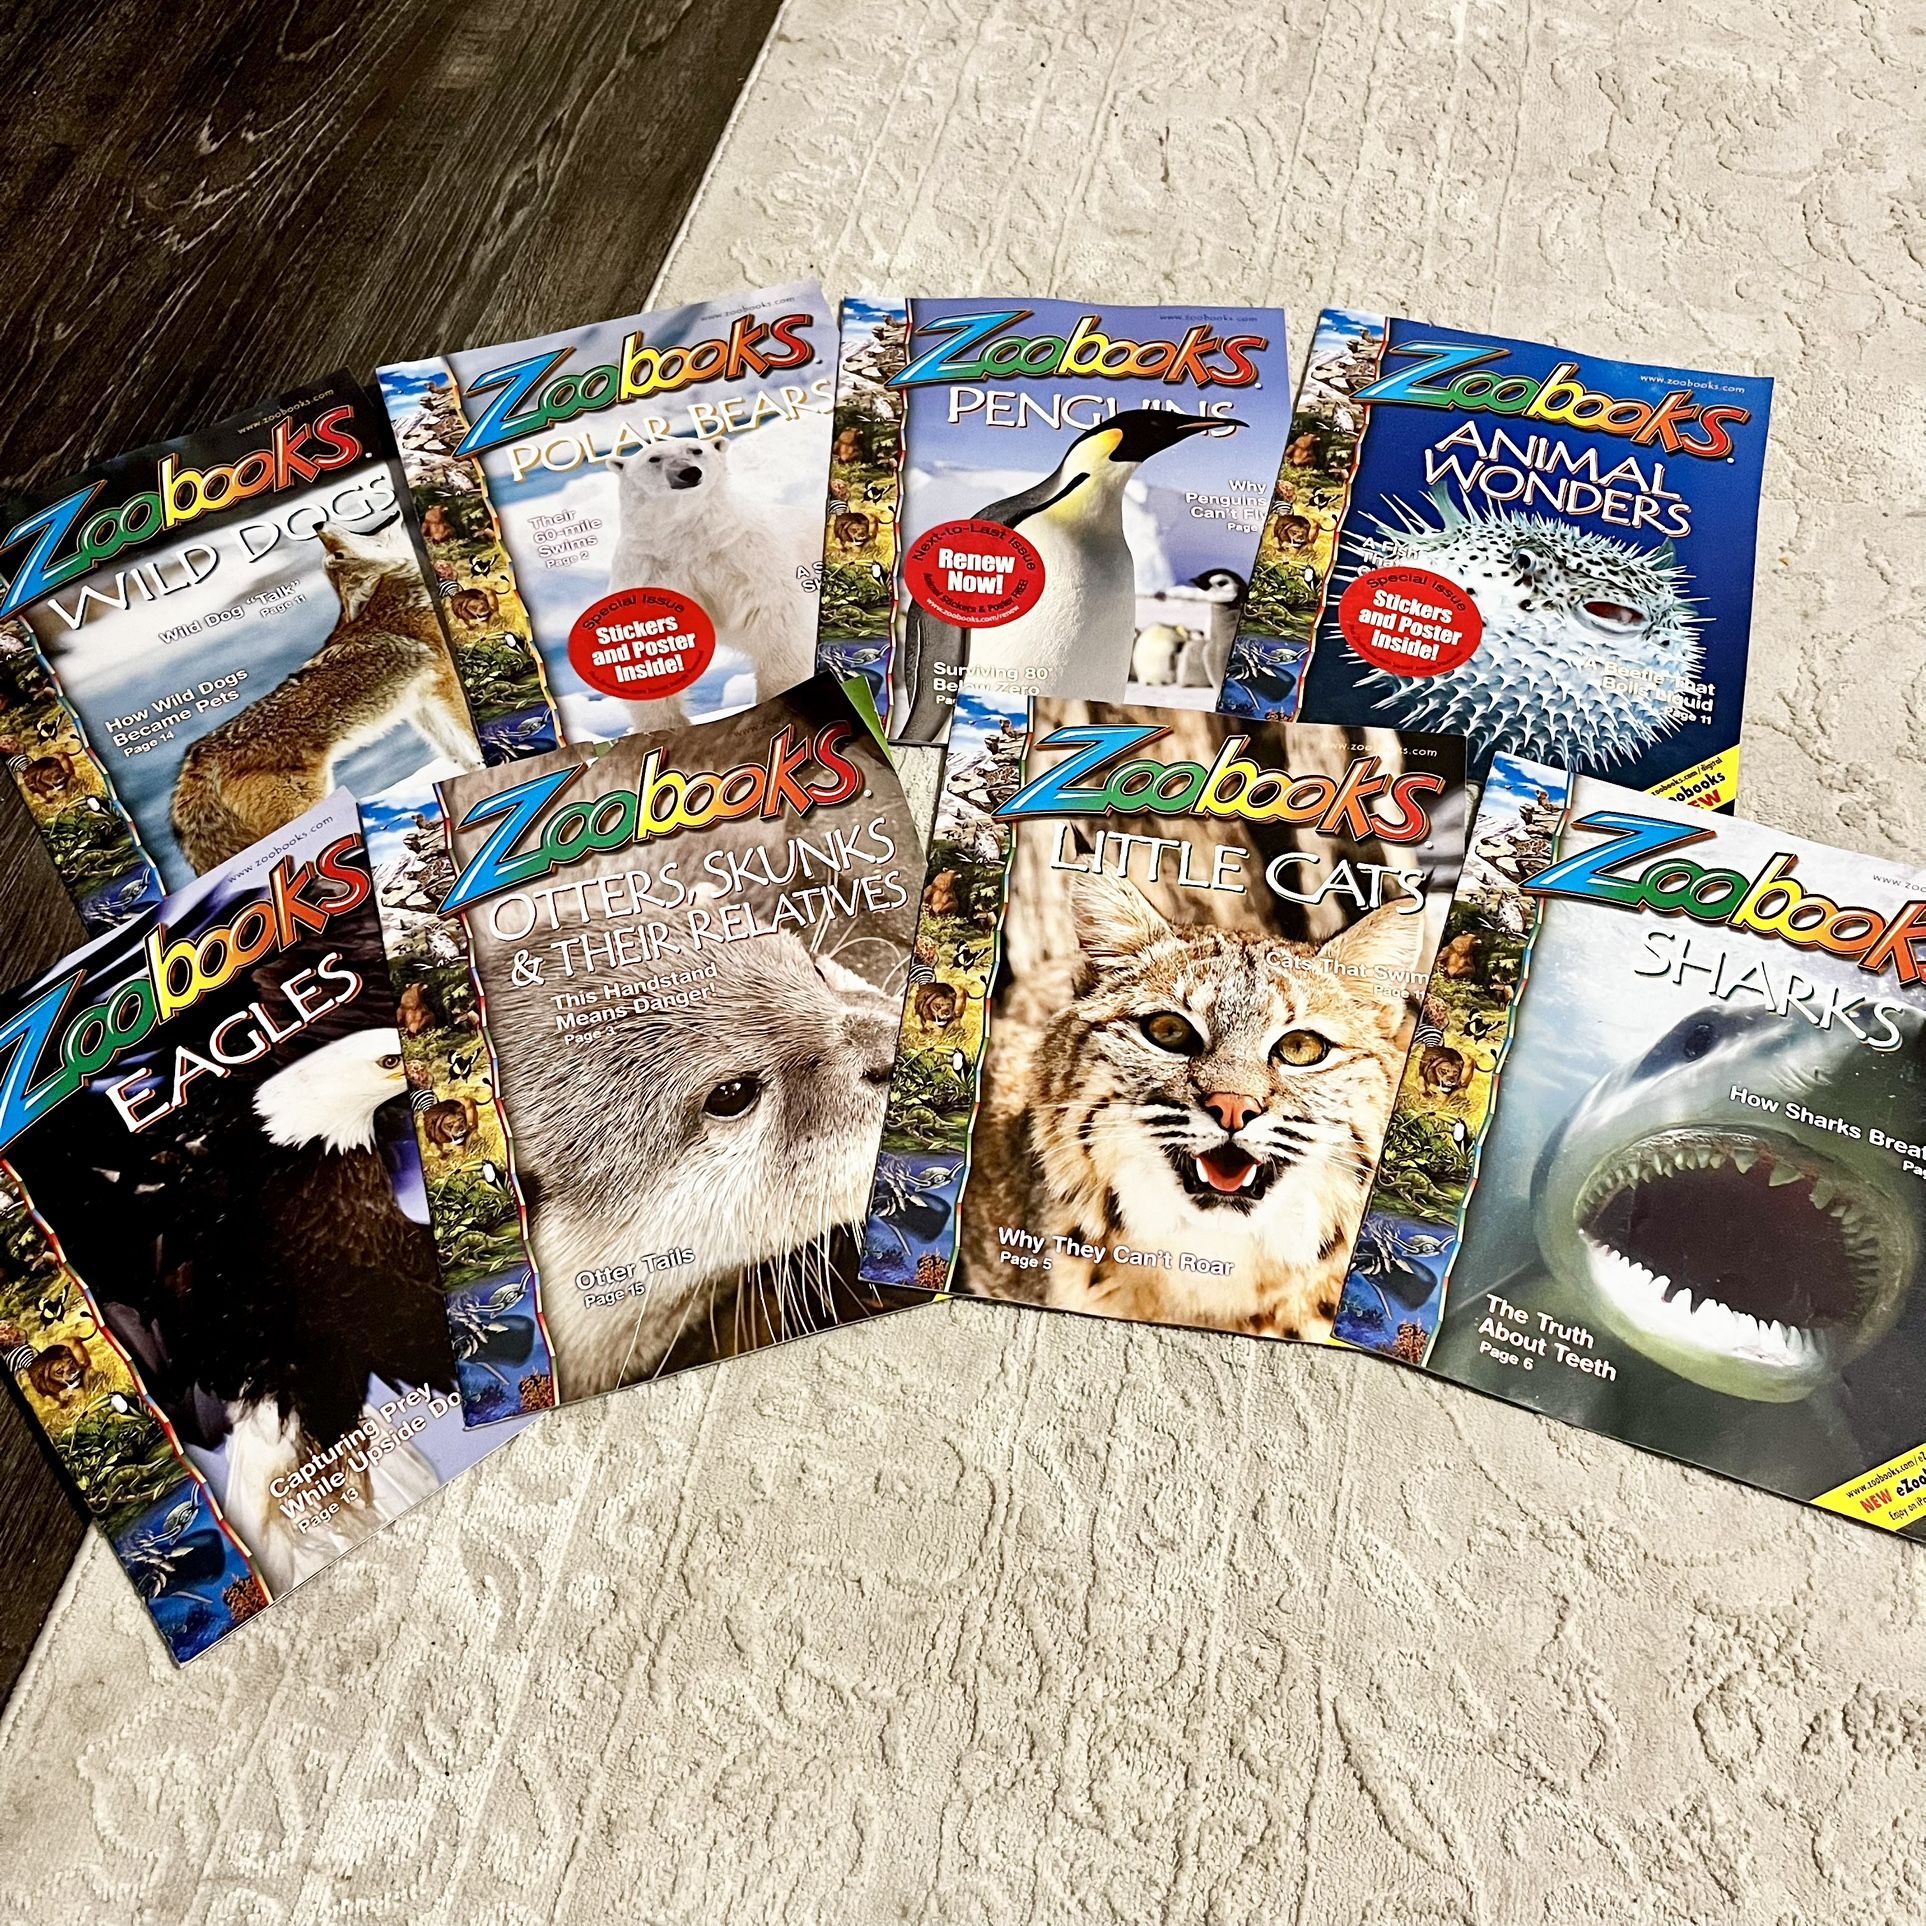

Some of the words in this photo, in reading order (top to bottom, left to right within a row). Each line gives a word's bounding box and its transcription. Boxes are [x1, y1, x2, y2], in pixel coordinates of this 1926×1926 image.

[1640, 375, 1745, 394] www.zoobooks.com
[237, 388, 335, 434] www.zoobooks.com
[509, 414, 678, 482] POLAR
[687, 378, 836, 441] BEARS
[1435, 420, 1682, 501] ANIMAL
[1185, 492, 1266, 507] Penguins
[1228, 480, 1267, 495] Why
[1424, 447, 1691, 538] WONDERS
[527, 509, 576, 529] Their
[1190, 506, 1237, 519] Can't
[1227, 522, 1258, 533] Page
[533, 519, 602, 544] 60-mile
[538, 535, 598, 558] Swims
[912, 523, 1008, 561] Next-to-Last
[1008, 537, 1036, 570] Issue
[1362, 537, 1376, 550] A
[1382, 541, 1419, 560] Fish
[47, 543, 218, 631] WILD
[230, 475, 399, 564] DOGS
[546, 555, 578, 569] Page
[580, 551, 589, 560] 2
[938, 547, 1015, 574] Renew
[796, 565, 810, 579] A
[947, 570, 1004, 595] Now!
[260, 602, 293, 618] Page
[295, 594, 306, 604] 11
[1366, 574, 1428, 589] Special
[1432, 580, 1467, 612] Issue
[1373, 589, 1453, 624] Stickers
[158, 620, 202, 644] Wild
[204, 606, 245, 627] Dog
[246, 579, 300, 605] “Talk”
[582, 595, 637, 631] Special
[642, 594, 685, 613] Issue
[926, 598, 1020, 623] www.zoobooks.com/renew
[1358, 608, 1397, 631] and
[1398, 615, 1463, 646] Poster
[596, 616, 678, 644] Stickers
[1371, 629, 1440, 662] Inside!
[592, 643, 630, 666] and
[632, 633, 696, 659] Poster
[615, 654, 684, 683] Inside!
[933, 661, 1018, 681] Surviving
[1583, 656, 1598, 670] A
[1604, 661, 1665, 685] Beetle
[1675, 676, 1716, 696] That
[105, 708, 149, 733] How
[151, 688, 195, 713] Wild
[197, 669, 248, 695] Dogs
[936, 695, 956, 705] Pa
[995, 683, 1040, 696] Zero
[1602, 676, 1648, 697] Boils
[1656, 689, 1713, 712] Liquid
[112, 709, 192, 747] Became
[195, 690, 240, 713] Pets
[1664, 706, 1697, 722] Page
[1701, 715, 1712, 725] 11
[123, 740, 158, 757] Page
[160, 731, 175, 742] 14
[488, 862, 697, 942] OTTERS,
[702, 816, 897, 900] SKUNKS
[1050, 823, 1250, 895] LITTLE
[1265, 851, 1427, 916] CATS
[1518, 810, 1926, 990] Zoobook
[511, 948, 545, 989] &
[550, 921, 681, 979] THEIR
[688, 870, 908, 952] RELATIVES
[1265, 951, 1313, 971] Cats
[1319, 957, 1368, 978] That
[1372, 964, 1430, 985] Swim
[550, 990, 598, 1010] This
[603, 962, 718, 1000] Handstand
[1373, 984, 1411, 1000] Page
[1633, 928, 1906, 1052] SHARKS
[555, 1006, 628, 1031] Means
[633, 982, 718, 1013] Danger!
[105, 952, 364, 1133] EAGLES
[564, 1028, 602, 1046] Page
[1729, 1085, 1780, 1113] How
[1784, 1102, 1862, 1140] Sharks
[998, 1226, 1045, 1254] Why
[1051, 1234, 1107, 1264] They
[1112, 1244, 1173, 1270] Can't
[1178, 1252, 1236, 1277] Roar
[1000, 1251, 1038, 1271] Page
[1042, 1257, 1053, 1271] 5
[575, 1263, 636, 1291] Otter
[641, 1247, 696, 1274] Tails
[583, 1290, 625, 1310] Page
[628, 1281, 646, 1297] 15
[1486, 1293, 1529, 1325] The
[1536, 1311, 1594, 1350] Truth
[1478, 1317, 1547, 1357] About
[1554, 1342, 1617, 1382] Teeth
[1479, 1340, 1520, 1365] Page
[1523, 1357, 1534, 1371] 6
[269, 1418, 381, 1499] Capturing
[379, 1382, 432, 1423] Prey
[279, 1470, 346, 1520] While
[348, 1416, 427, 1474] Upside
[298, 1501, 340, 1534] Page
[340, 1487, 359, 1503] 13
[1859, 1488, 1892, 1514] NEW
[1908, 1503, 1917, 1512] on
